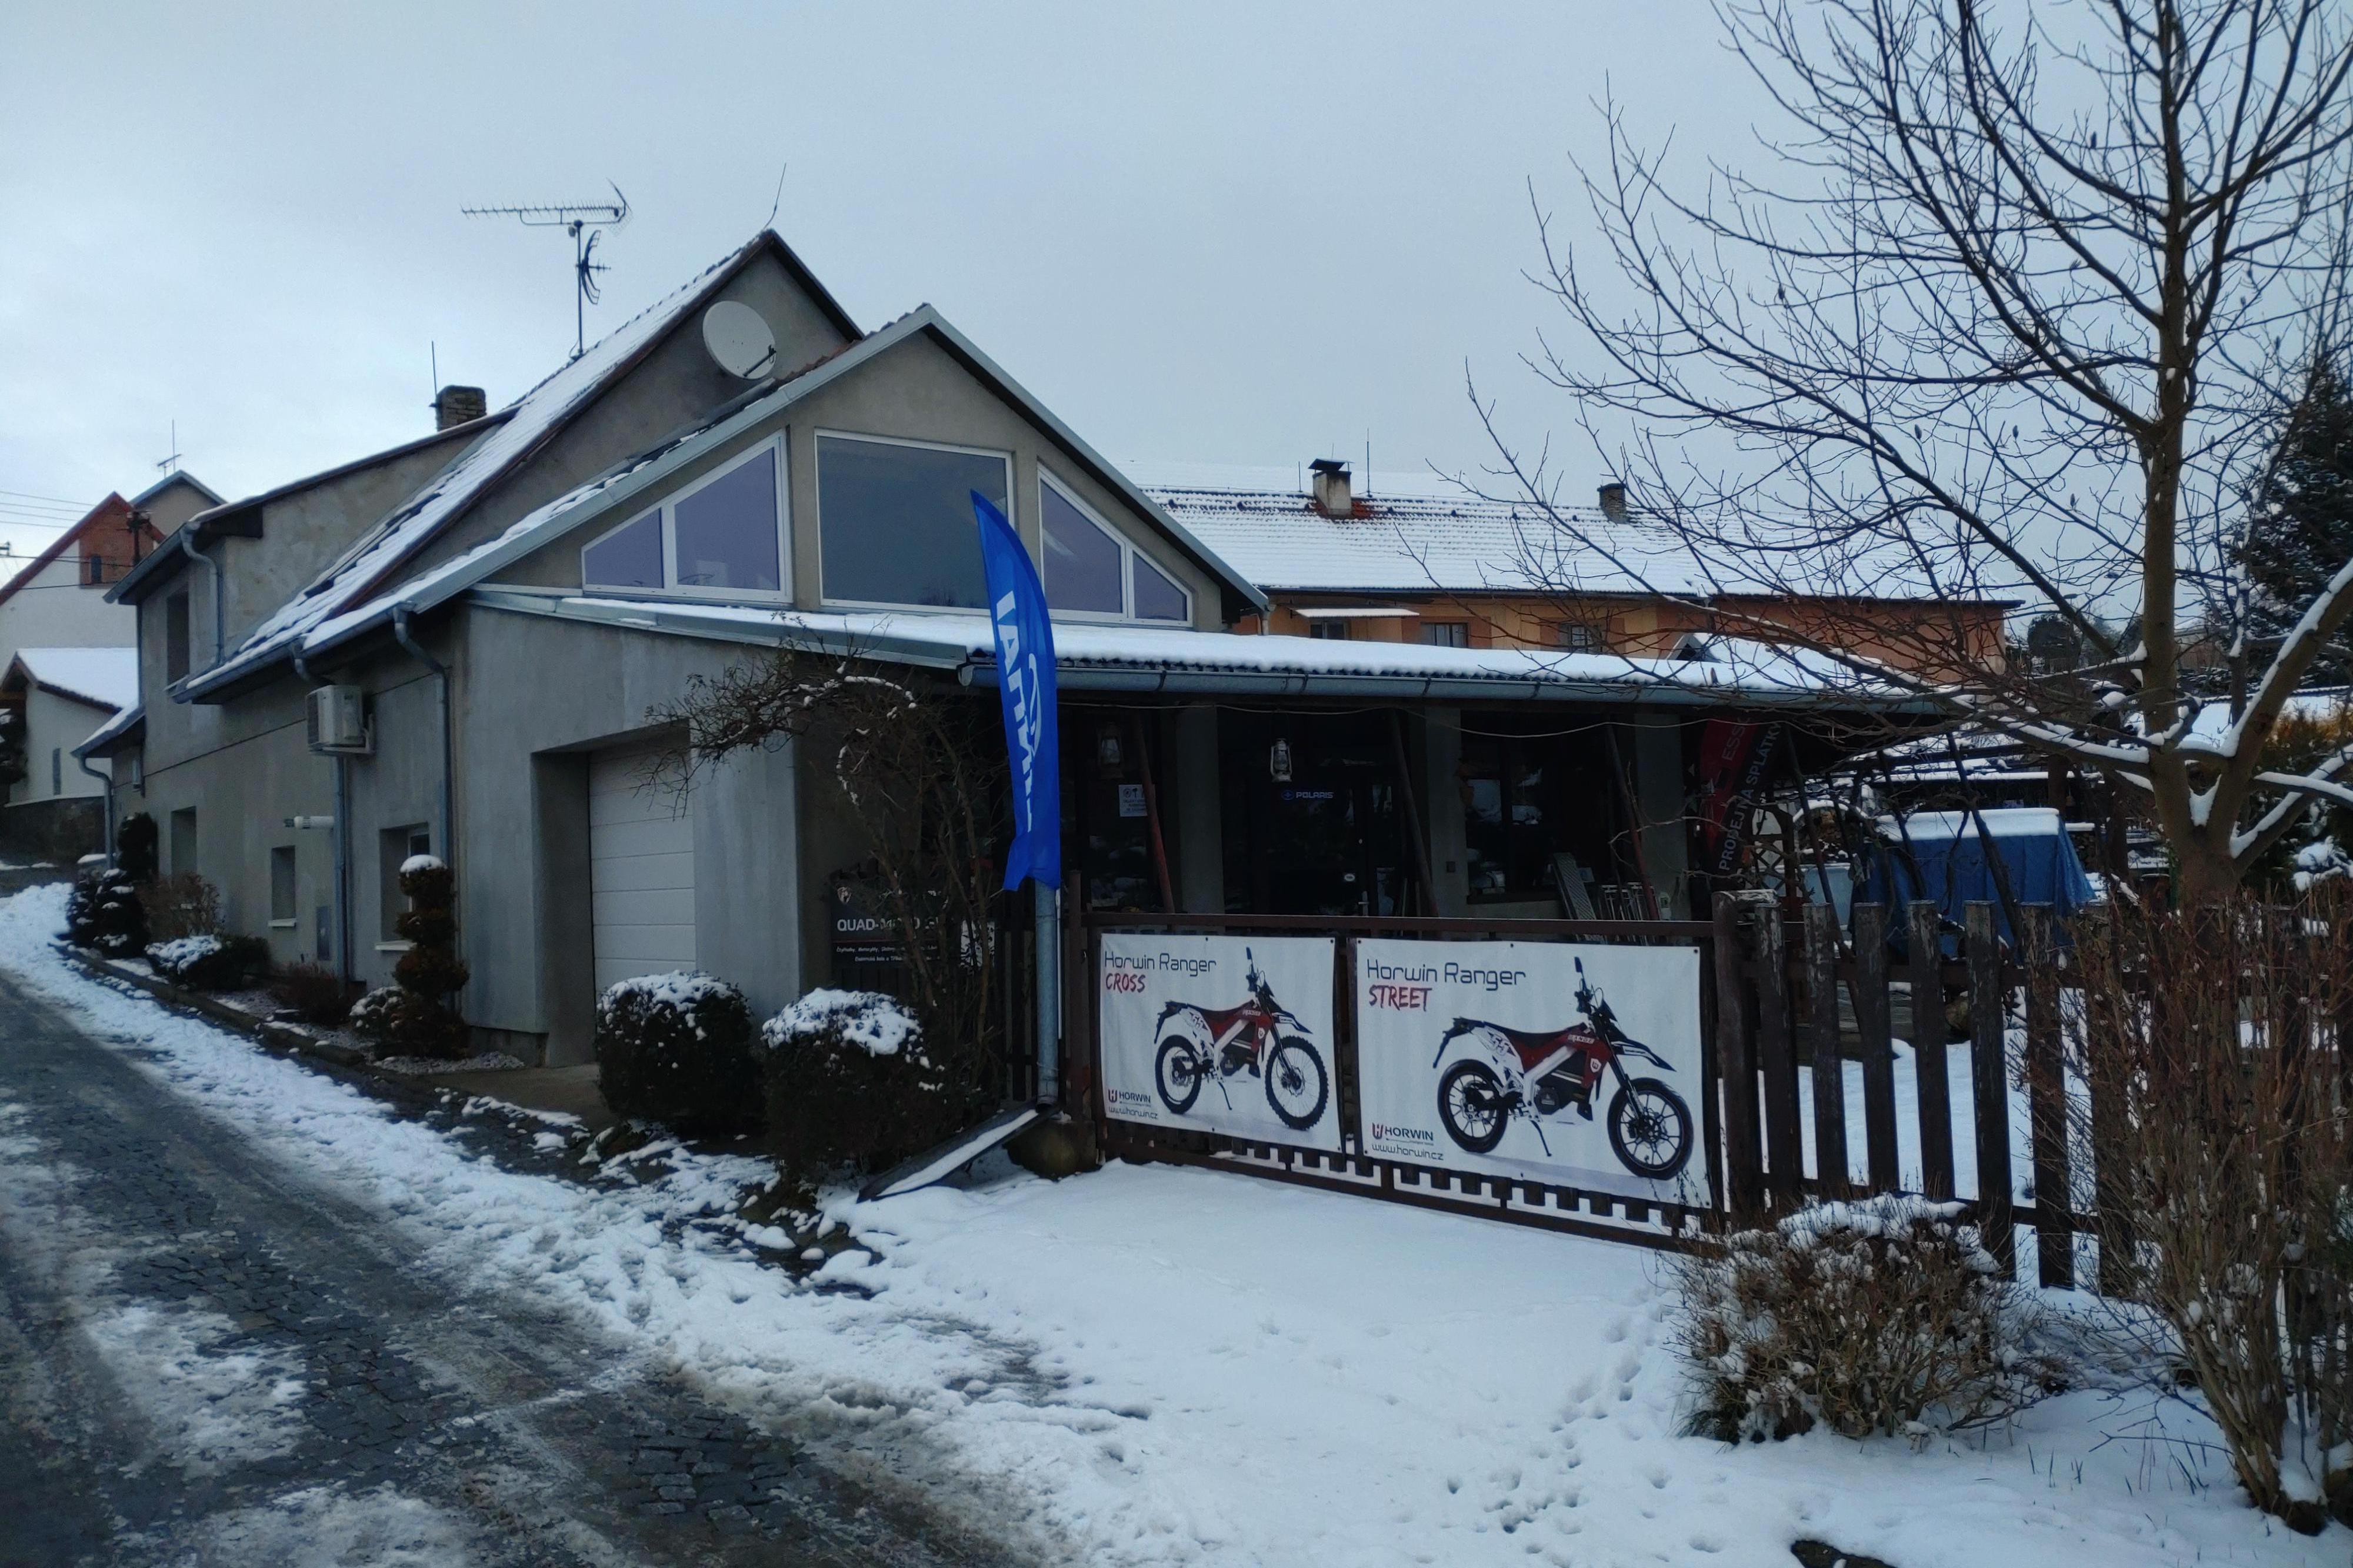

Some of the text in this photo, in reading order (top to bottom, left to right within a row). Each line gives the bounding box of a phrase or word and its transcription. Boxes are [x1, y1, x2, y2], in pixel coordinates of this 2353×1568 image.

[1104, 950, 1217, 977] Horwin Ranger
[1367, 958, 1527, 991] Horwin Ranger
[1105, 973, 1146, 993] CROSS
[1369, 985, 1432, 1012] STREET
[1119, 1091, 1151, 1103] HORWIN
[1385, 1126, 1434, 1141] HORWIN
